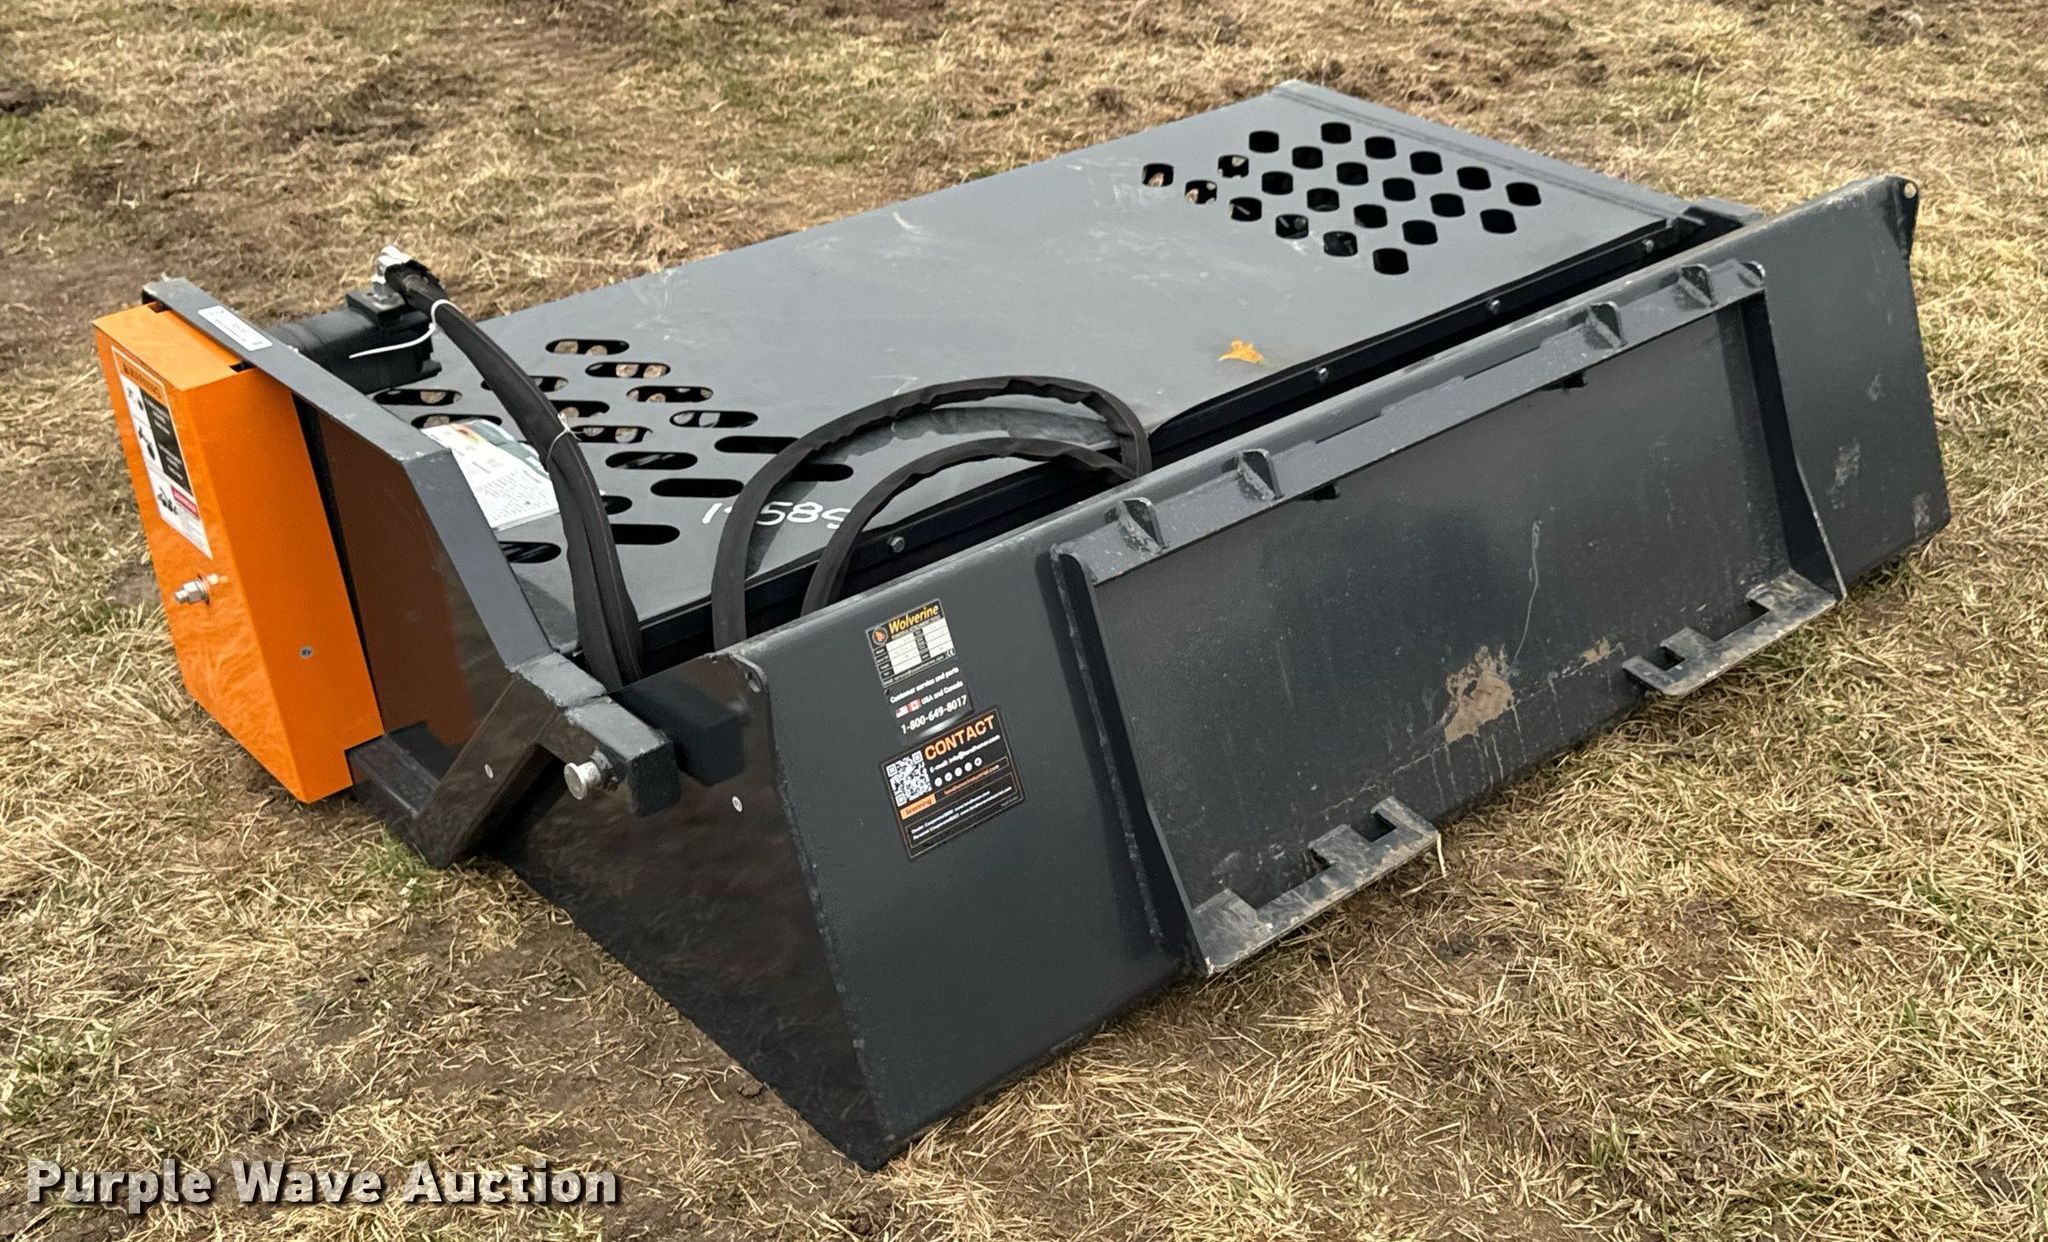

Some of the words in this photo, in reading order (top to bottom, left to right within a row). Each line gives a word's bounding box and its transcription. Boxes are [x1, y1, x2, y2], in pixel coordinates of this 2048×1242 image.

[888, 605, 939, 635] Wolverine
[890, 687, 916, 704] Customer
[916, 678, 935, 692] service
[935, 672, 945, 682] and
[945, 667, 959, 679] parts
[921, 694, 934, 705] USA
[933, 689, 944, 700] and
[943, 680, 964, 694] Canada
[901, 695, 967, 734] 1-800-649-8017
[924, 715, 994, 760] CONTACT
